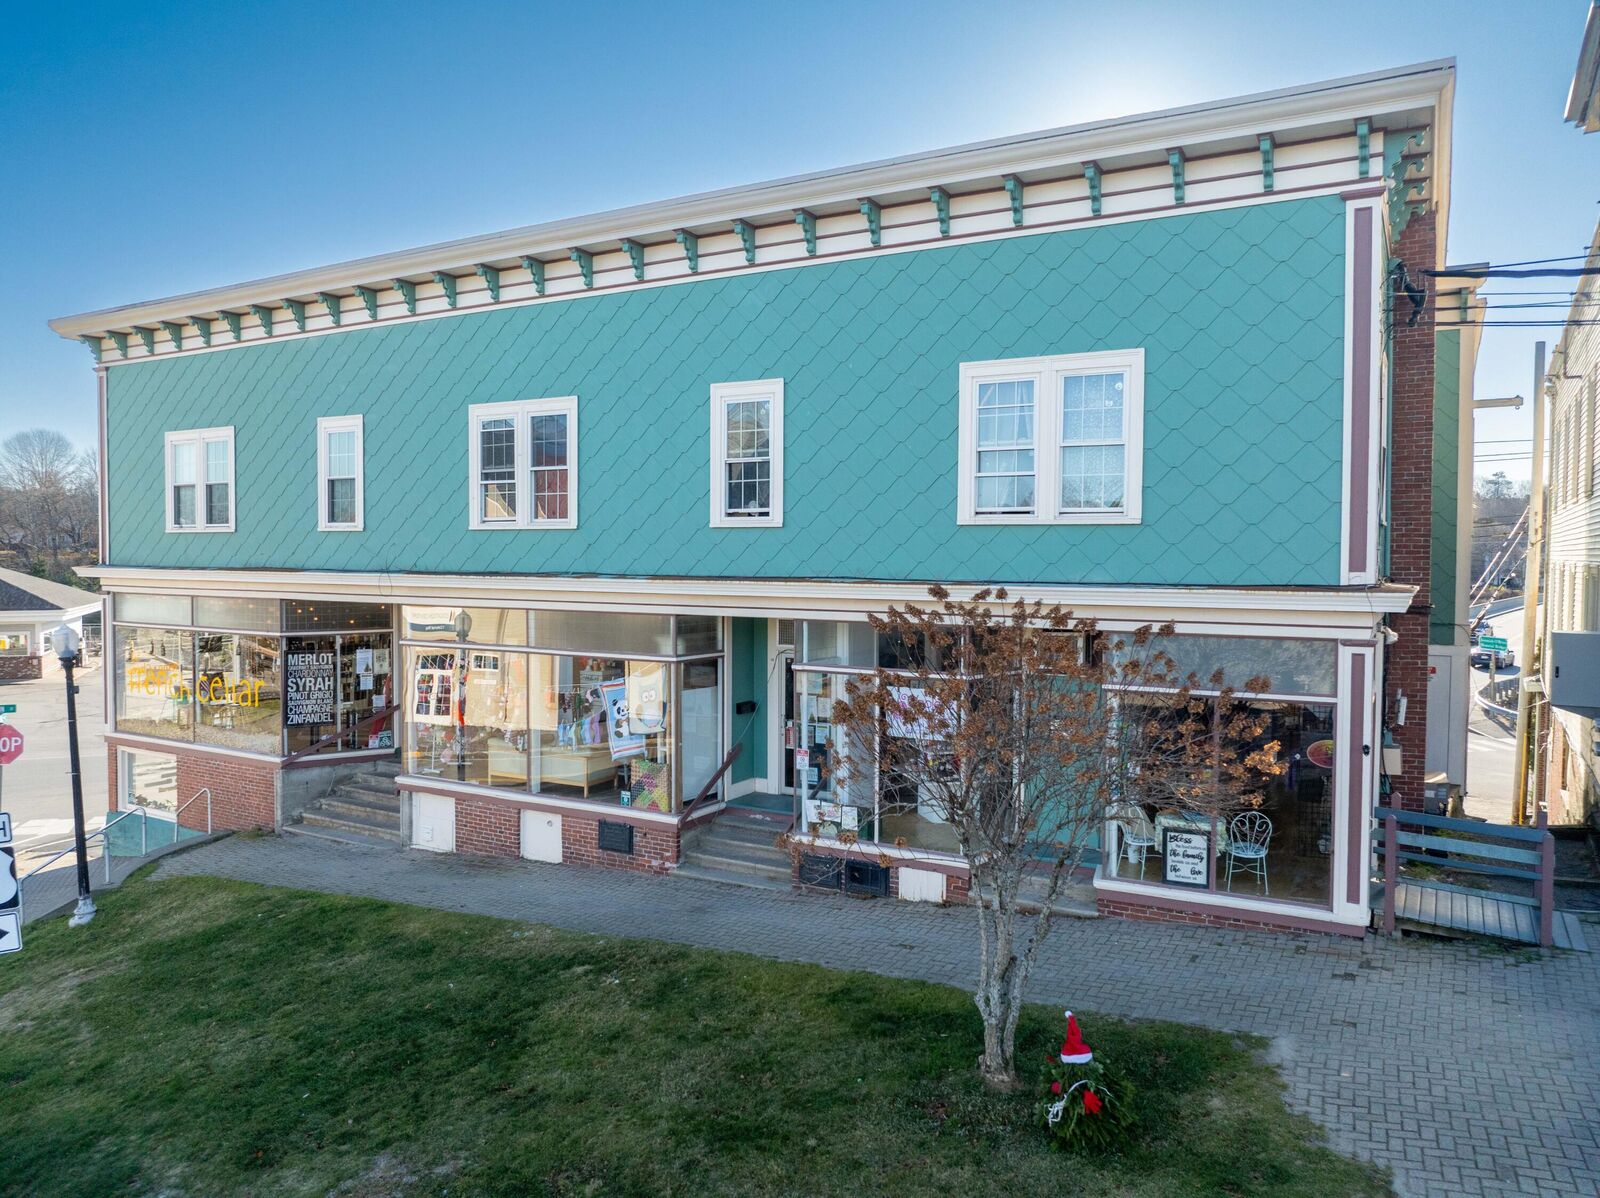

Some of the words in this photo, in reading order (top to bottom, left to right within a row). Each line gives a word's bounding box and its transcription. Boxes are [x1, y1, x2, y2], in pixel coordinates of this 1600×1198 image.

[287, 653, 334, 666] MERLOT
[287, 669, 334, 679] CHARDONNAY
[287, 677, 334, 692] SYRAH
[287, 691, 309, 700] PINOT
[310, 690, 334, 699] GRIGIO
[287, 704, 334, 715] CHAMPAGNE
[287, 712, 334, 725] ZINFANDEL
[0, 736, 21, 752] OP
